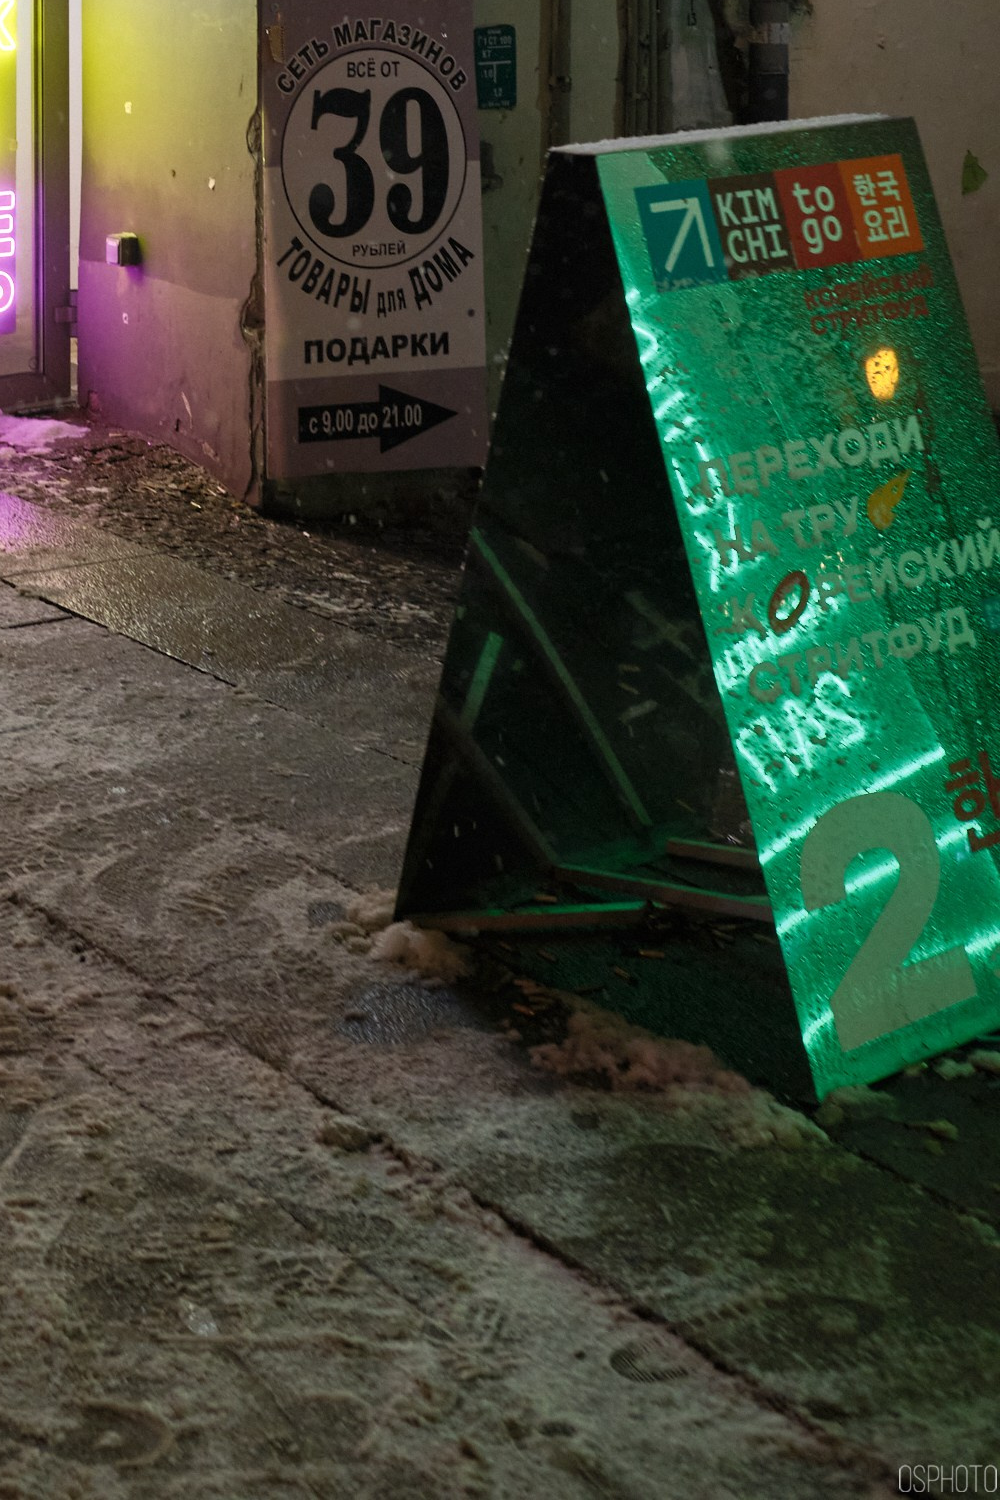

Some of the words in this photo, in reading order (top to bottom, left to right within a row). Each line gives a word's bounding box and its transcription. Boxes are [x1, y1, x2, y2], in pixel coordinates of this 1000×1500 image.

[276, 36, 330, 94] СЕТЬ
[333, 18, 468, 93] МАГАЗИНОВ
[346, 58, 376, 78] ВСЁ
[380, 61, 401, 77] ОТ
[309, 87, 450, 238] 39
[852, 170, 901, 207] 한국
[716, 187, 779, 227] KIM
[792, 182, 835, 215] to
[863, 205, 910, 242] 요리
[352, 240, 406, 257] РУБЛЕЙ
[727, 225, 788, 263] CHI
[801, 215, 842, 254] go
[277, 236, 371, 314] ТОВАРЫ
[377, 288, 407, 318] для
[408, 236, 475, 311] ДОМА
[304, 332, 449, 366] ПОДАРКИ
[309, 417, 318, 434] с
[322, 410, 353, 434] 9.00
[357, 415, 378, 434] до
[382, 404, 422, 428] 21.00
[694, 415, 925, 500] ПЕРЕХОДИ
[713, 518, 780, 566] НА
[781, 496, 859, 550] ТРУ
[714, 516, 1000, 640] КОРЕЙСКИЙ
[748, 606, 977, 702] СТРИТФУД
[800, 791, 978, 1052] 2
